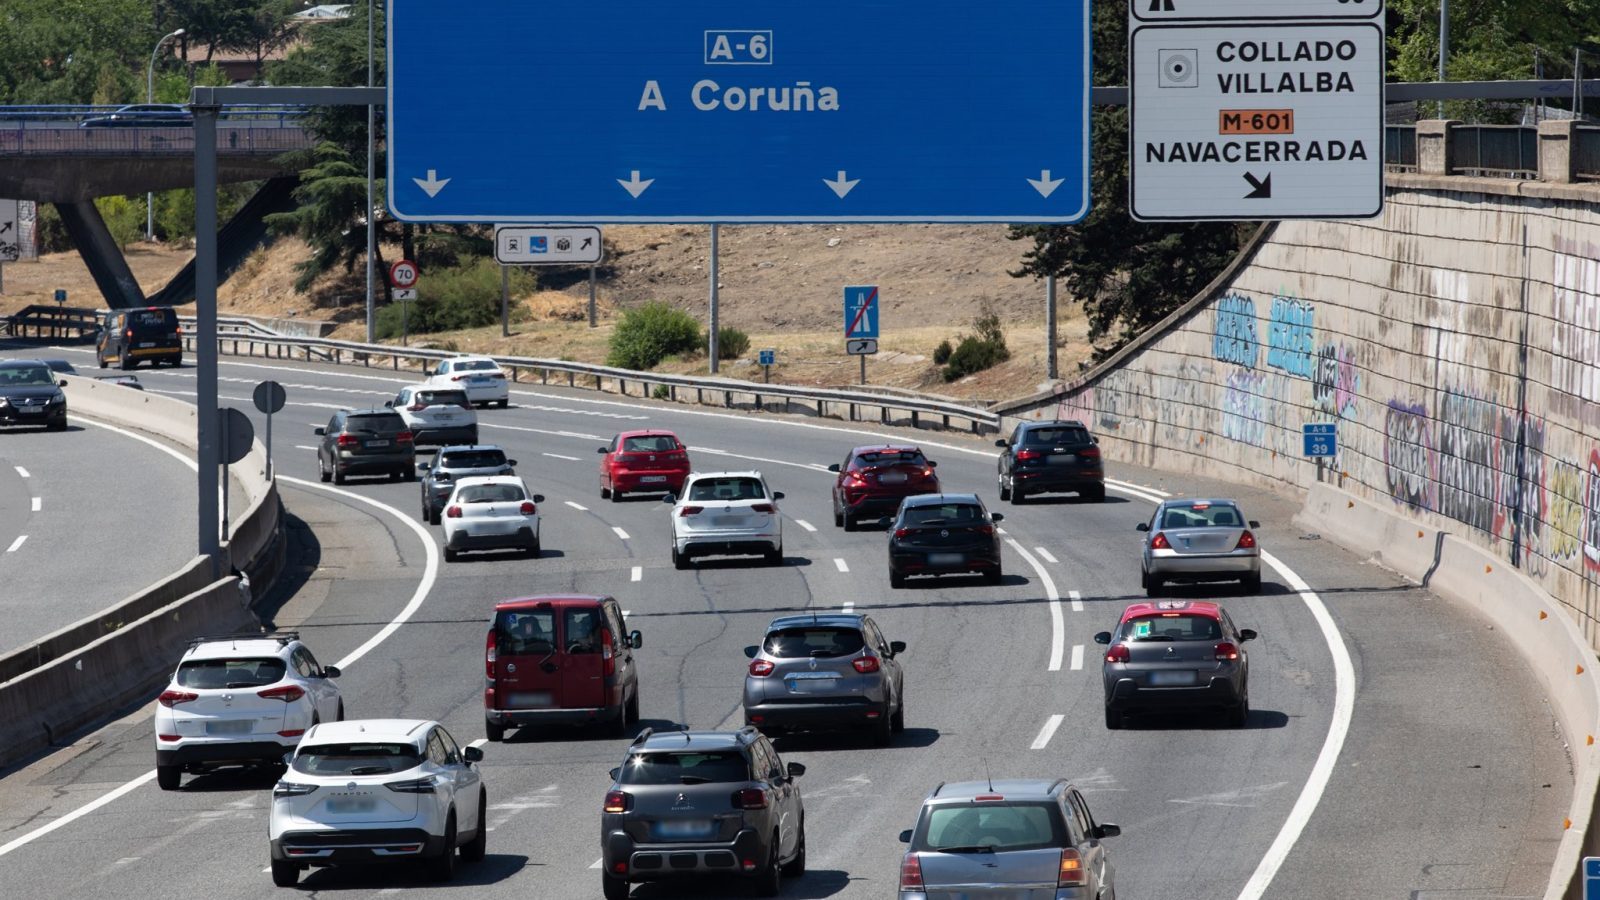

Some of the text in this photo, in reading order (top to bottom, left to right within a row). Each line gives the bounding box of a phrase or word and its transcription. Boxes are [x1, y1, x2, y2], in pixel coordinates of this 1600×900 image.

[710, 35, 768, 60] A-6
[1216, 40, 1357, 63] COLLADO
[1217, 71, 1355, 94] VILLALBA
[638, 79, 840, 111] A Coruña
[1223, 113, 1290, 131] M-601
[1146, 140, 1368, 163] NAVACERRADA
[398, 269, 412, 280] 70
[1312, 425, 1327, 433] A-6
[1312, 443, 1328, 454] 39
